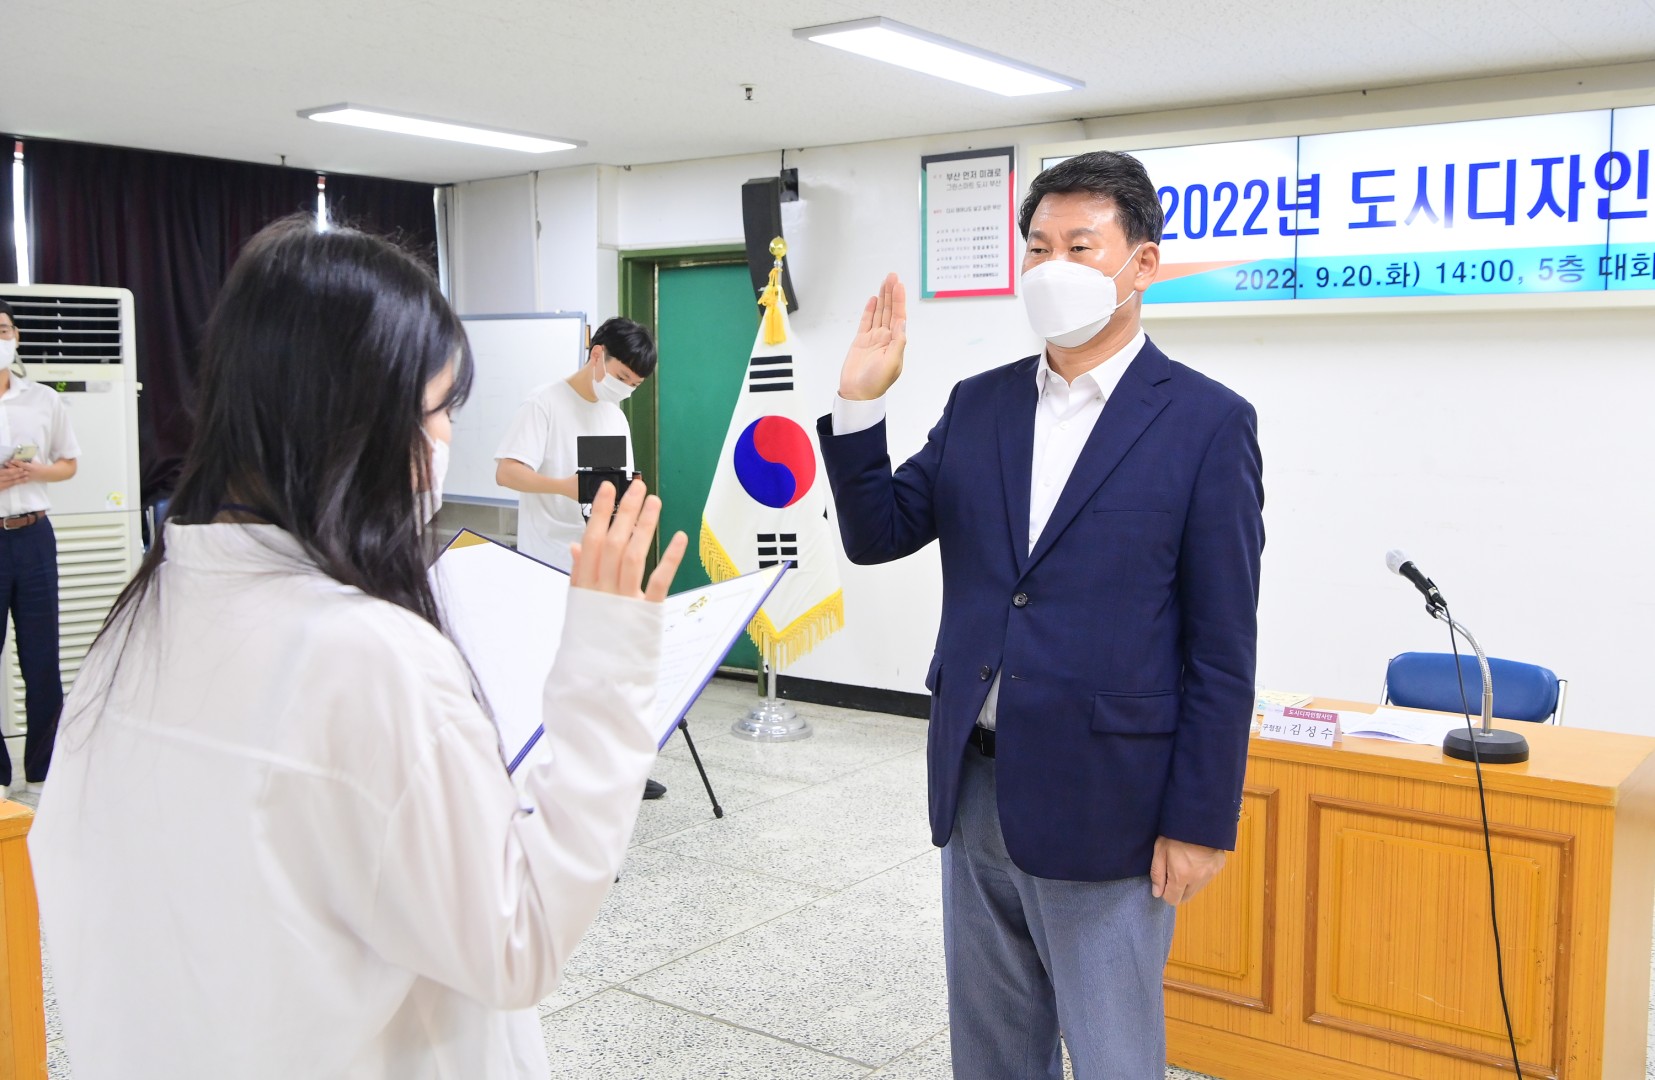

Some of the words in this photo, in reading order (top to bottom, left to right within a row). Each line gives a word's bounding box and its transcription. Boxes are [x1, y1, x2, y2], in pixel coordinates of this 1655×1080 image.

[946, 172, 961, 181] 부산
[962, 170, 977, 180] 먼저
[979, 168, 1001, 178] 미래로
[1157, 173, 1321, 241] 2022년
[1348, 149, 1650, 230] 도시디자인
[1235, 268, 1304, 291] 2022.
[1315, 261, 1420, 288] 9.20.화)
[1435, 259, 1524, 285] 14:00,
[1538, 255, 1586, 283] 5층
[1598, 252, 1655, 281] 대회
